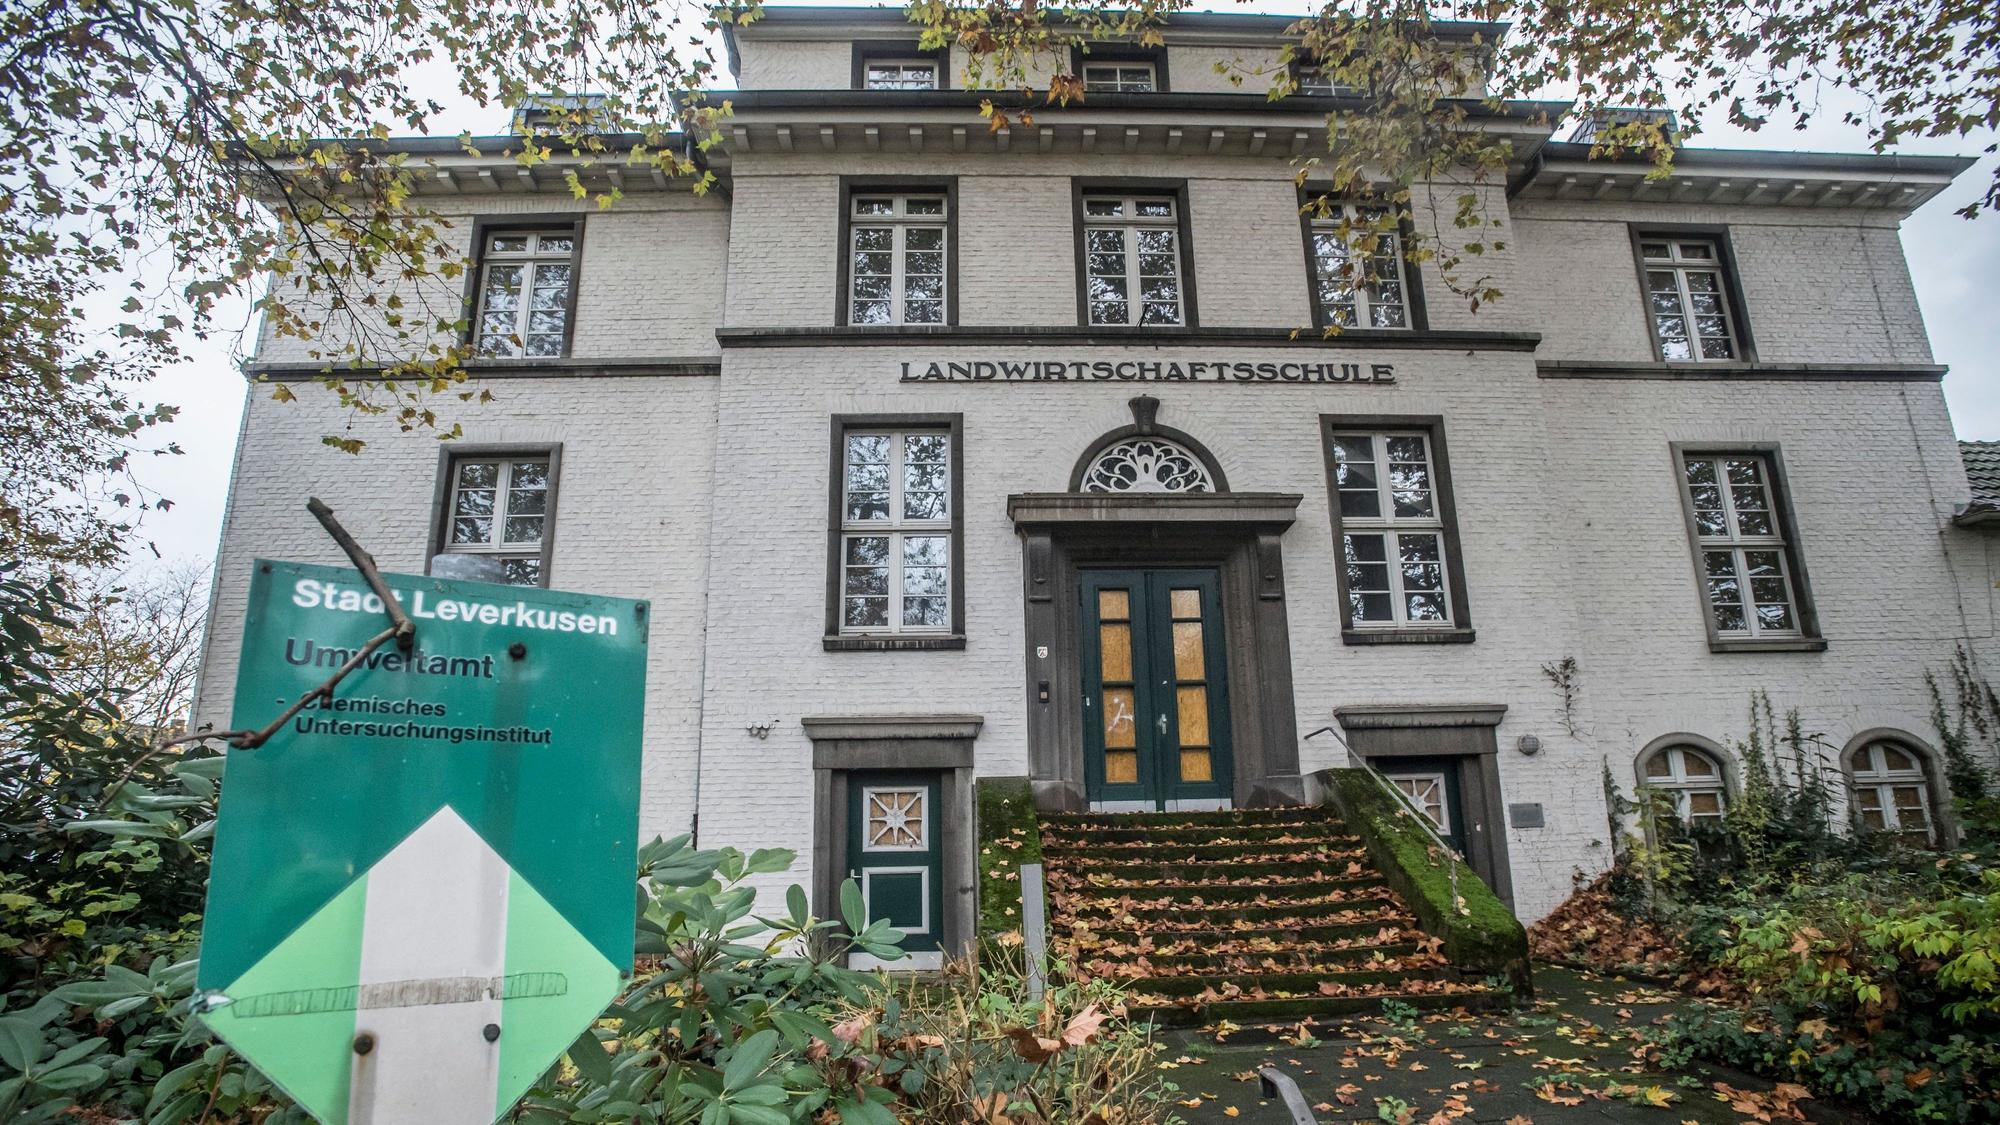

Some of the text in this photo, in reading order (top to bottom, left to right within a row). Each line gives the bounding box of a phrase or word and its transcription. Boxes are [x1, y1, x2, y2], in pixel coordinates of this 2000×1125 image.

[900, 361, 1395, 383] LANDWIRTSCHAFTSSCHULE
[412, 590, 618, 635] Leverkusen
[295, 716, 552, 745] Untersuchungsinstitut
